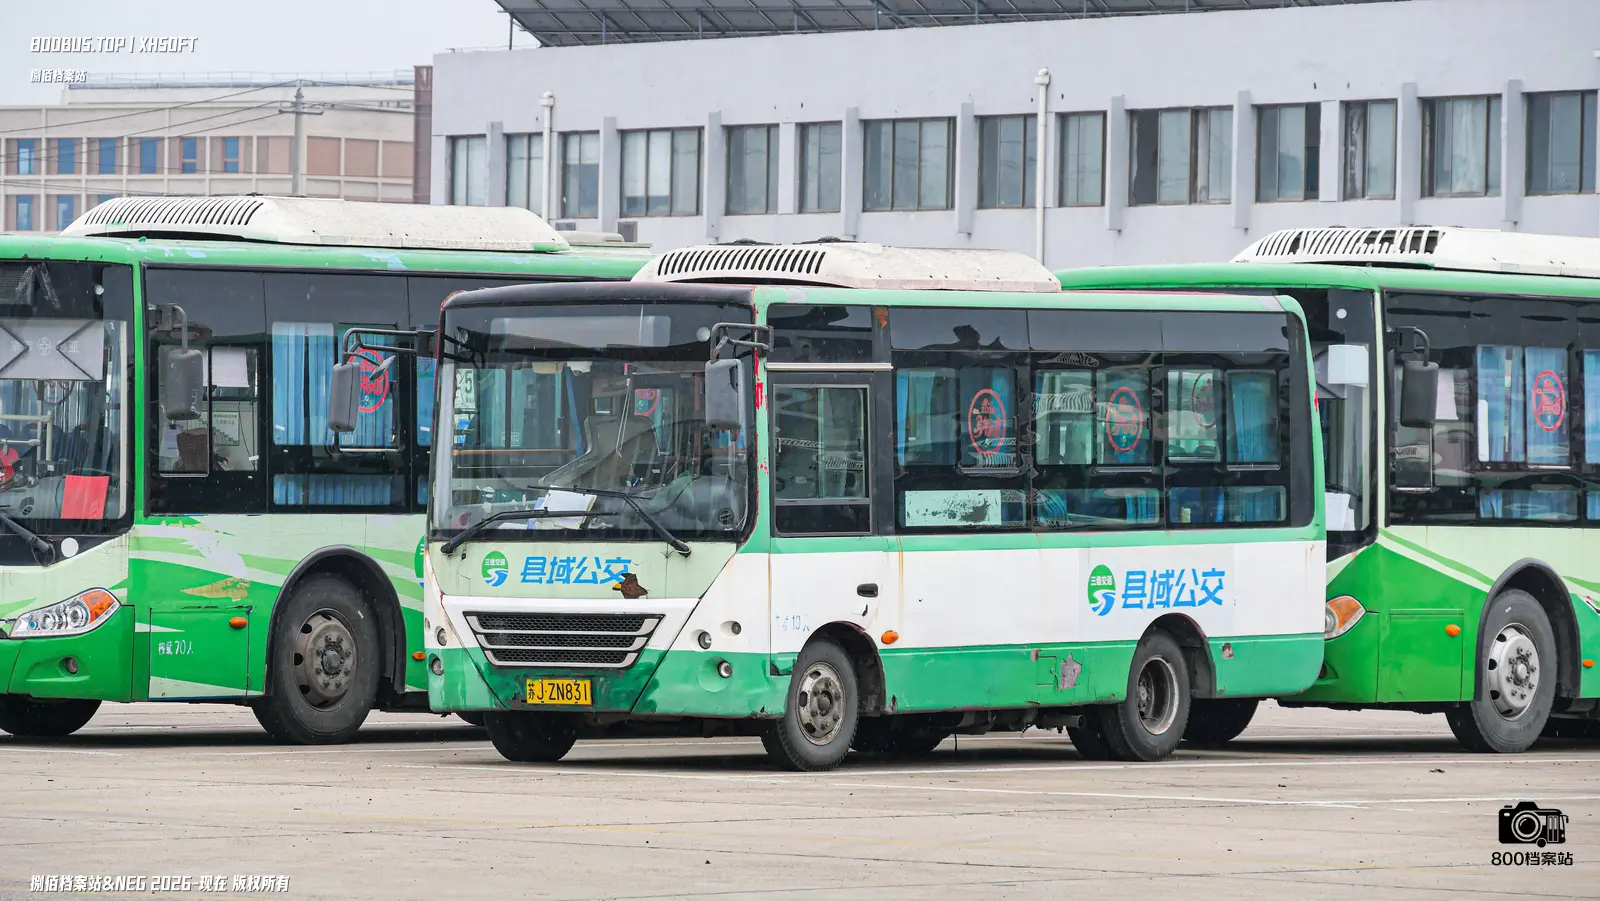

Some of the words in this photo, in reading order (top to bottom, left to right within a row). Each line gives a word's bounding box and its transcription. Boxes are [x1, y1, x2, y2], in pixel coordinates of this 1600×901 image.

[520, 555, 632, 585] 县域公交
[1121, 567, 1226, 609] 县域公交
